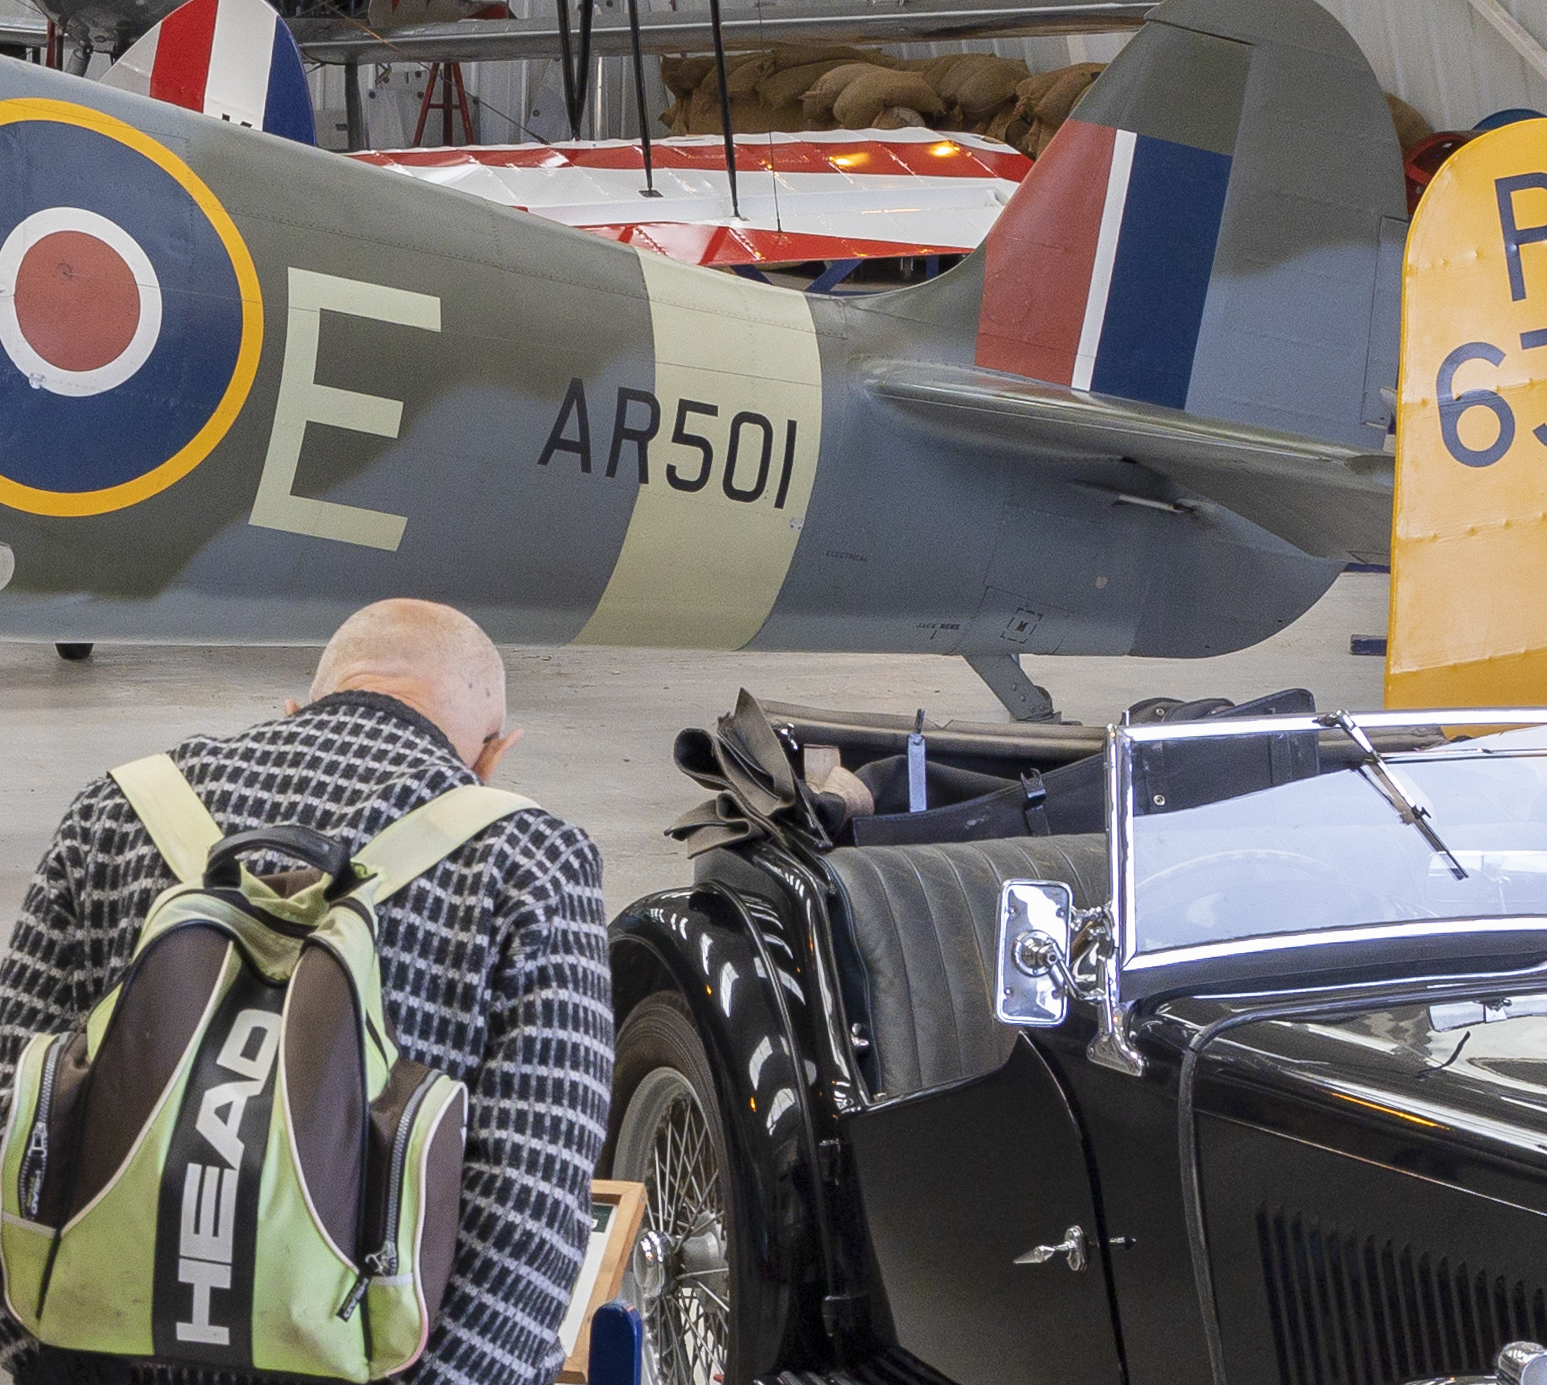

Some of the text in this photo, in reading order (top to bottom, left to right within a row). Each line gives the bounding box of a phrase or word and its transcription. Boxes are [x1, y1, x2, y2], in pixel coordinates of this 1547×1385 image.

[249, 266, 442, 552] E
[537, 377, 798, 510] AR501
[175, 1008, 283, 1347] HEAD
